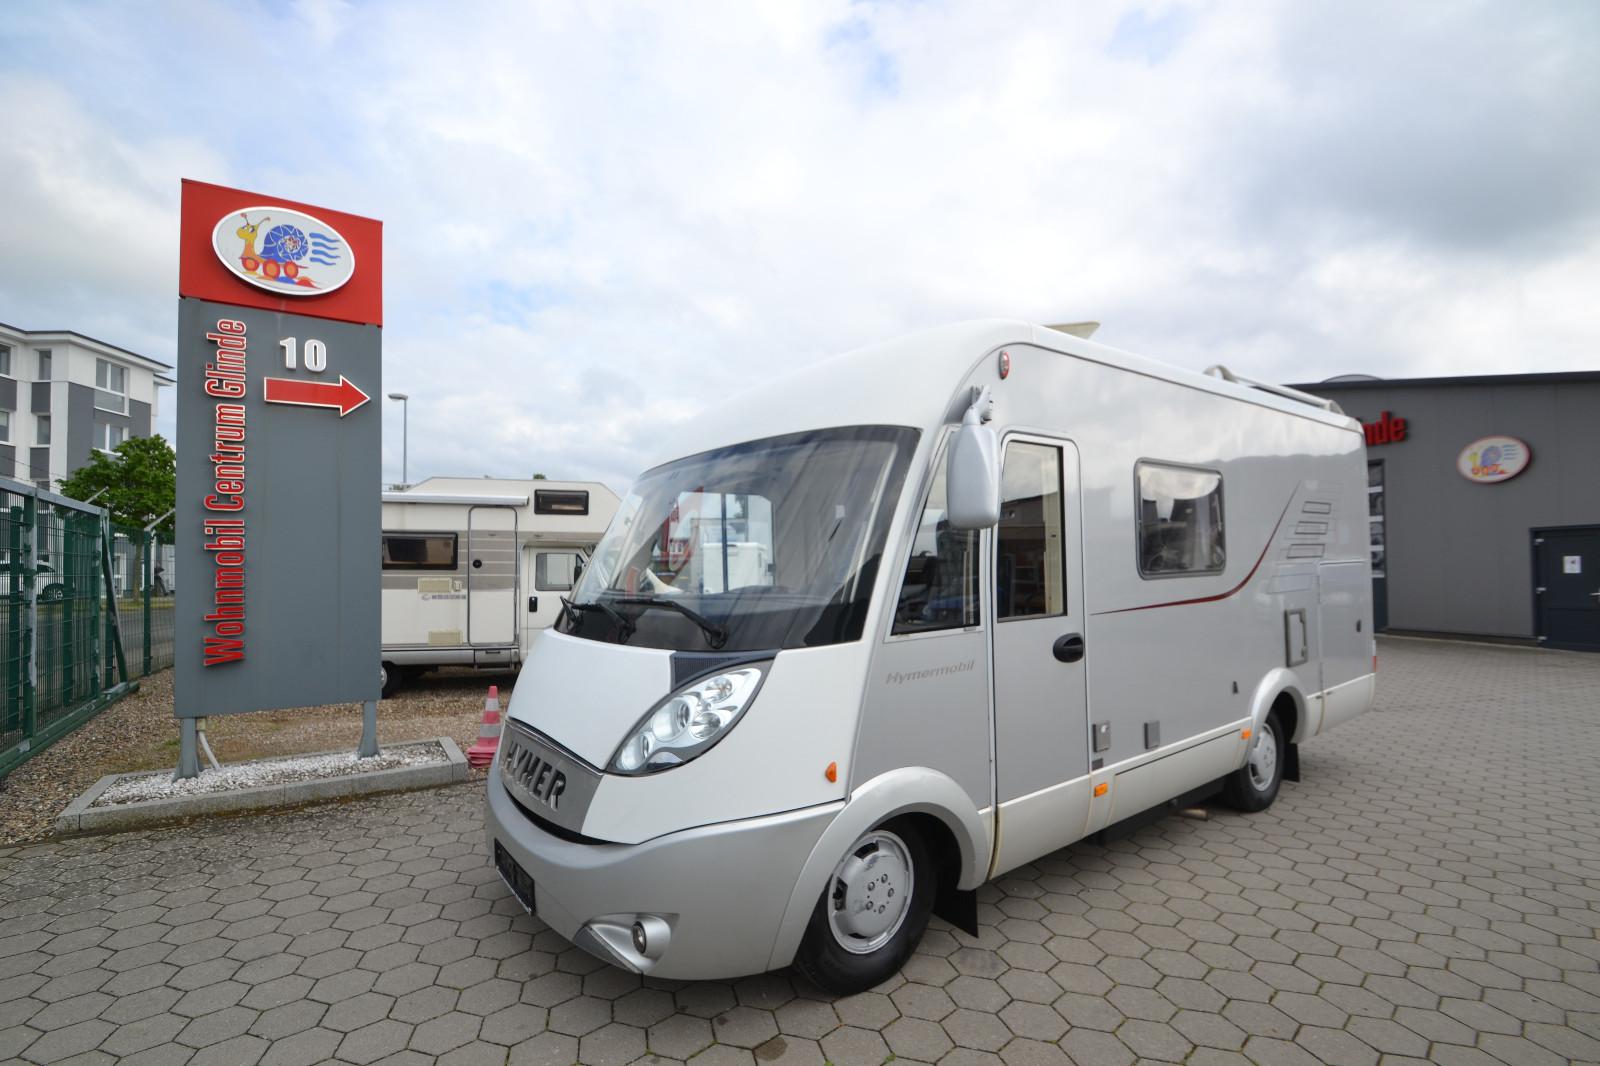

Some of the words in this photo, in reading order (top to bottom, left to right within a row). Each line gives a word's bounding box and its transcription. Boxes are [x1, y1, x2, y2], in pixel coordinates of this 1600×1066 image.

[204, 319, 246, 398] Glinde
[279, 337, 327, 372] 10
[204, 403, 245, 511] Centrum
[1358, 410, 1408, 447] nde
[204, 519, 245, 666] Wohnmobil
[885, 660, 975, 685] Hymermobil
[503, 740, 567, 812] HYMER
